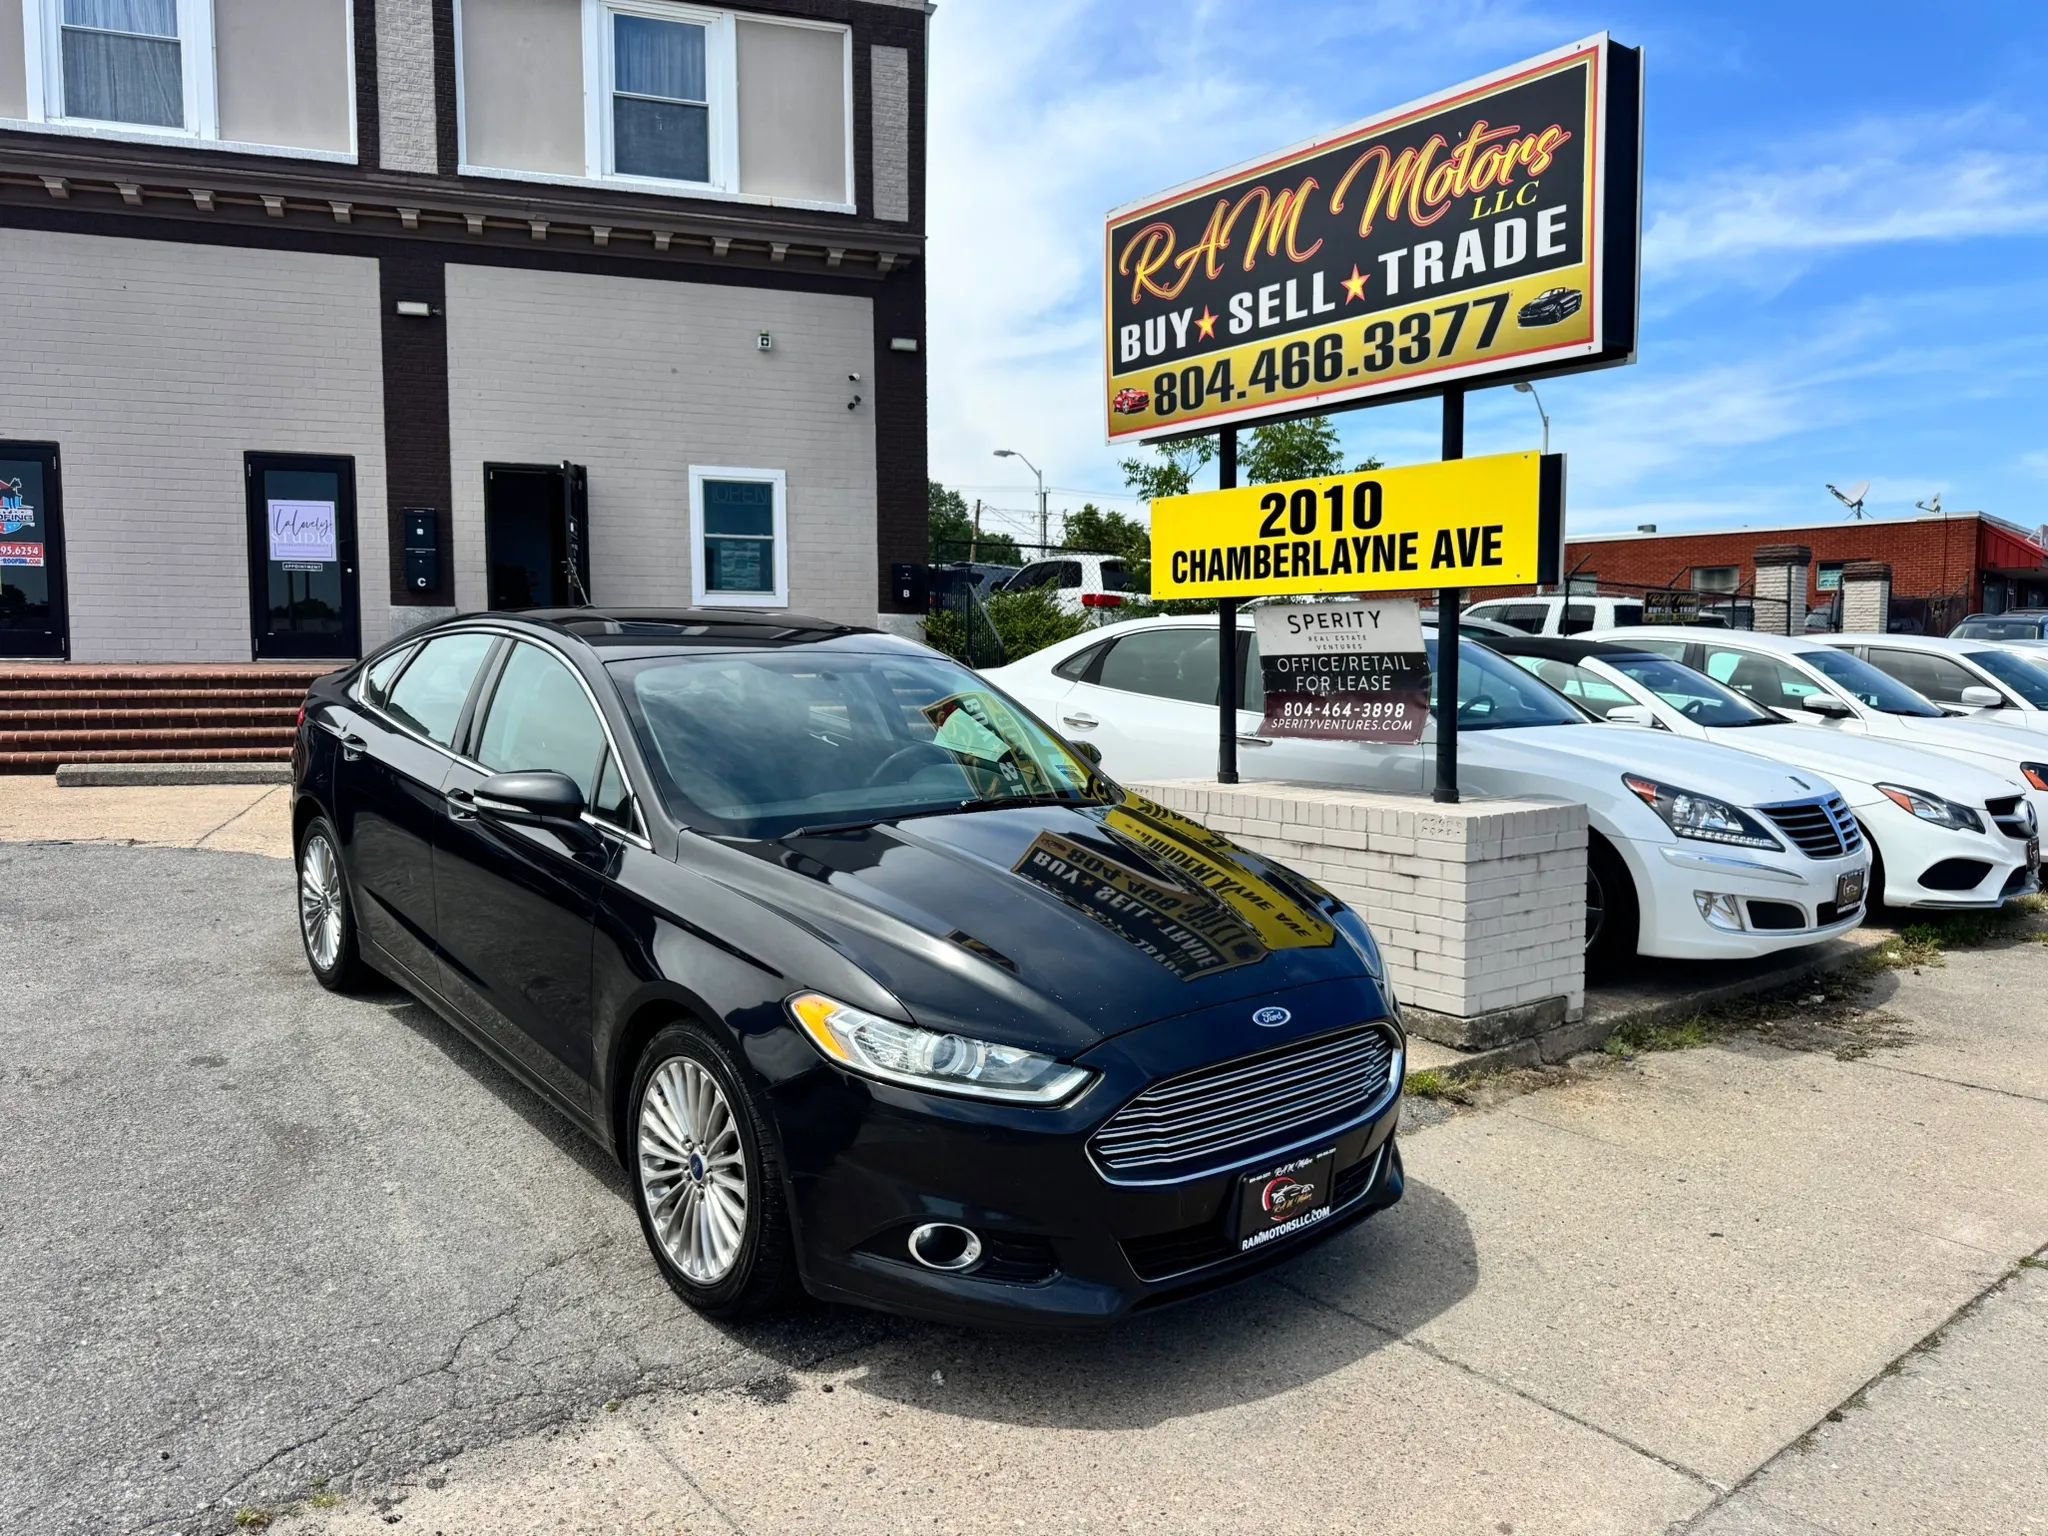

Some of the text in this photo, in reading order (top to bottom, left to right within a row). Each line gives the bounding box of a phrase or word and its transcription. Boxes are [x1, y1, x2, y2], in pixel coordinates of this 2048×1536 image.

[1119, 120, 1571, 305] RAM Motors
[1469, 180, 1540, 220] LLC
[1120, 204, 1567, 363] BUY SELL TRADE
[1154, 293, 1511, 417] 804.466.3377
[1258, 480, 1384, 538] 2010
[1172, 525, 1503, 584] CHAMBERLAYNE AVE
[1287, 610, 1381, 634] SPERITY
[1277, 655, 1411, 672] OFFICE/RETAIL
[1296, 675, 1392, 692] FOR LEASE
[1271, 718, 1413, 731] SPERITYVENTURES.COM
[1284, 702, 1405, 718] 804-464-3898
[1242, 1206, 1330, 1251] RAMMOTORSLLC.COM
